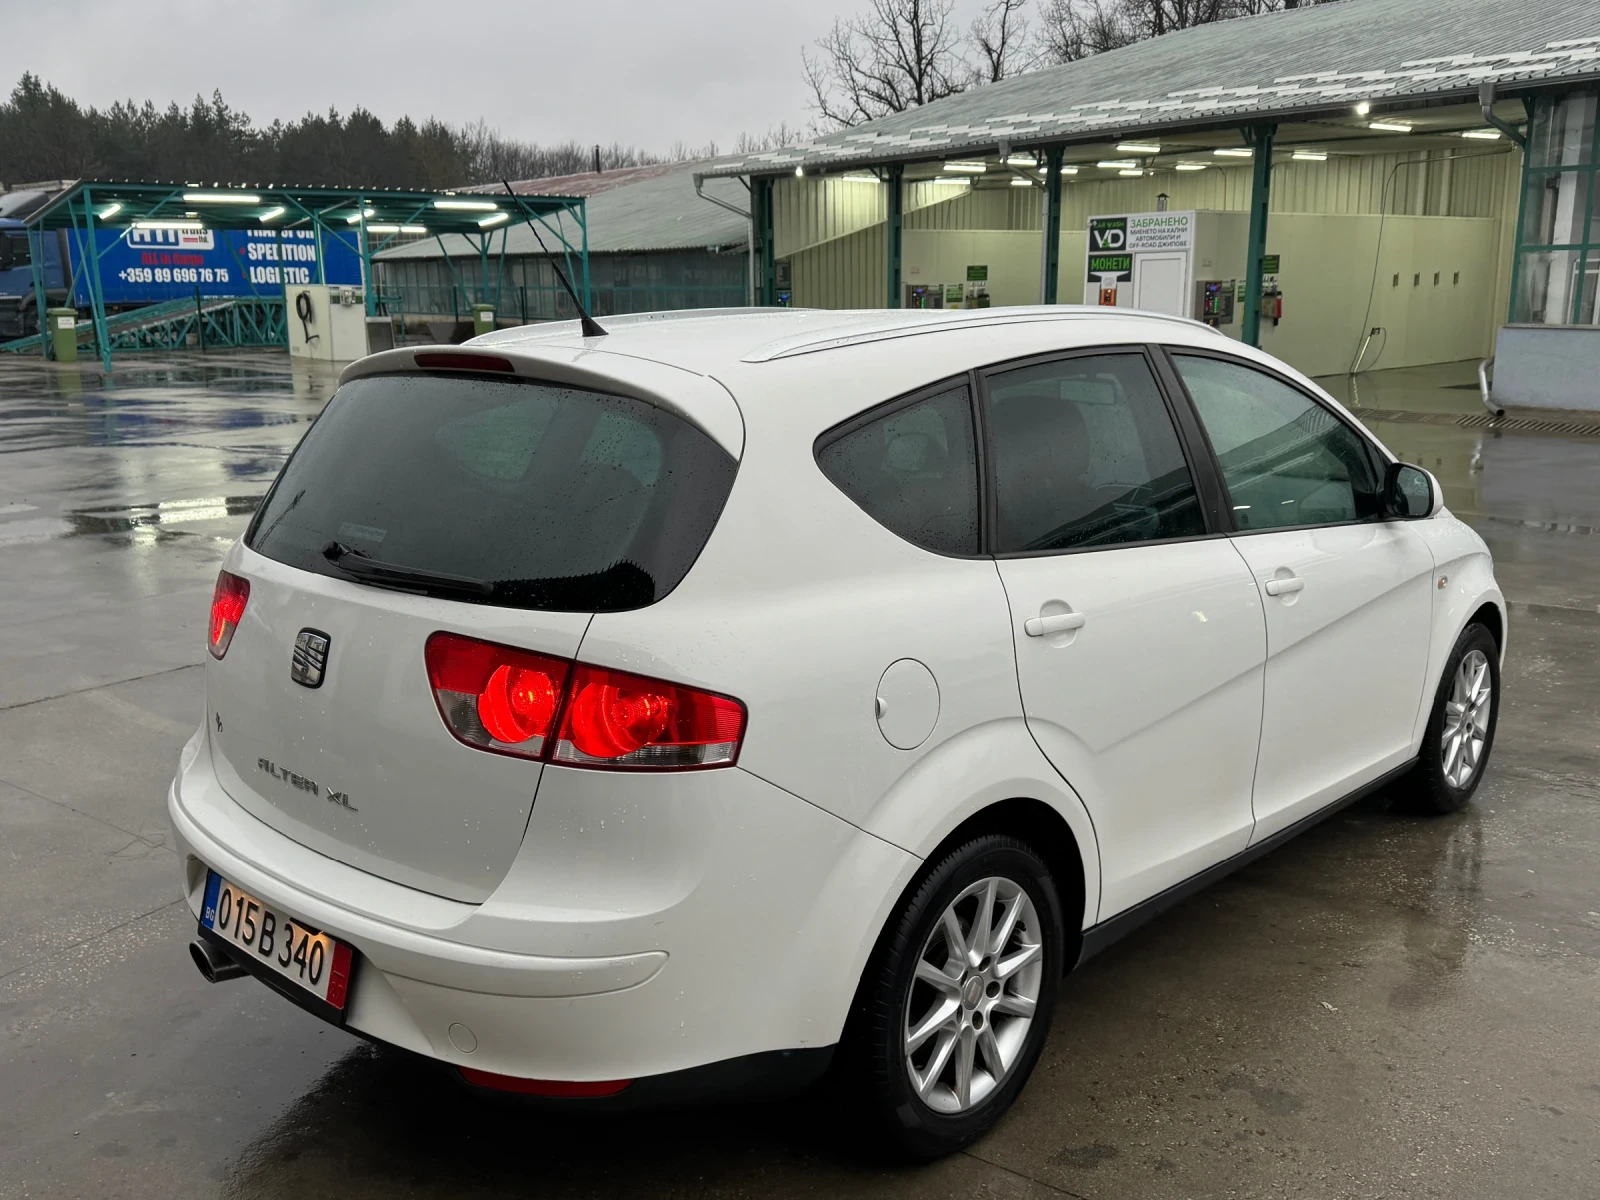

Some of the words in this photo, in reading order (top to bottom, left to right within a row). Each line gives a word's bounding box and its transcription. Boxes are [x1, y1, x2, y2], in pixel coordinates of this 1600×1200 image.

[1130, 216, 1188, 229] ЗАБРАНЕНО
[1167, 226, 1188, 234] КАЛНИ
[1157, 240, 1188, 248] ДЖИПОВЕ
[1091, 257, 1130, 271] МОНЕТИ
[118, 267, 153, 283] +359
[154, 267, 171, 283] 89
[173, 267, 198, 283] 696
[199, 268, 213, 283] 76
[214, 268, 229, 283] 75
[257, 756, 319, 797] ALTEA
[326, 786, 359, 812] XL
[205, 906, 215, 921] BG
